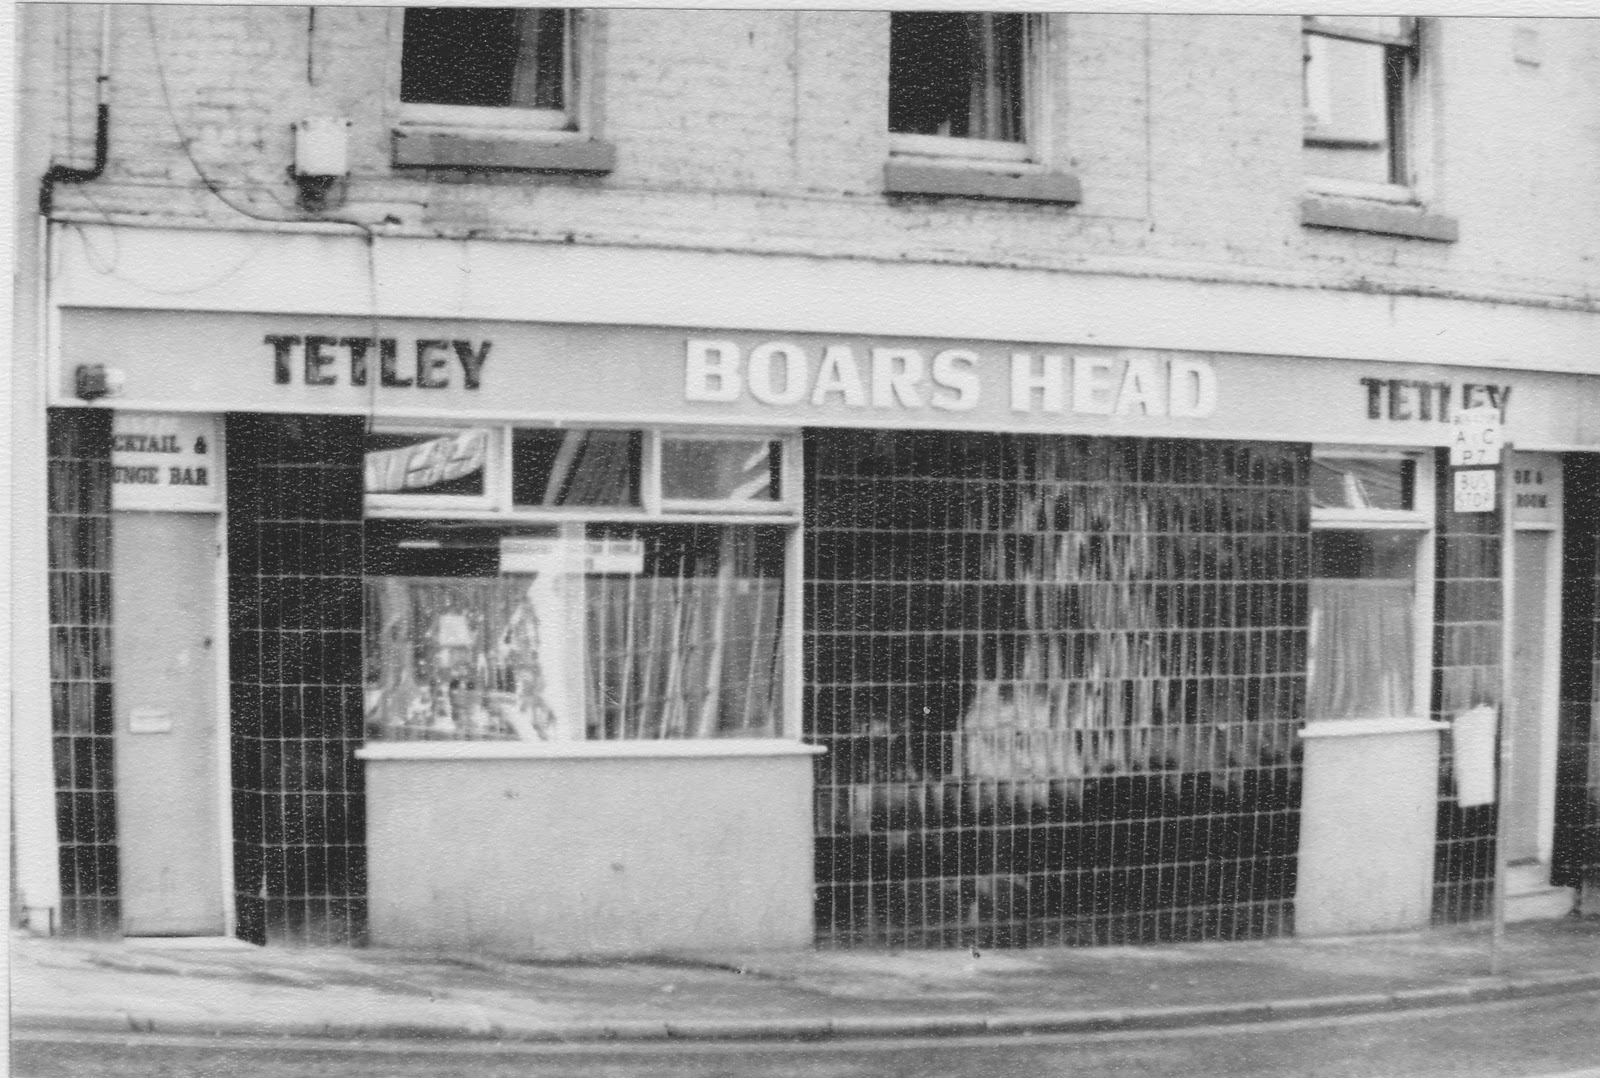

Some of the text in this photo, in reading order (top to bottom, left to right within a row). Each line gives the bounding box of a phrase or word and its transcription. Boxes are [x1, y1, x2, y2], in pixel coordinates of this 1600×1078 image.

[264, 334, 493, 390] TETLEY
[685, 338, 1217, 418] BOARS HEAD
[168, 466, 208, 486] BAR
